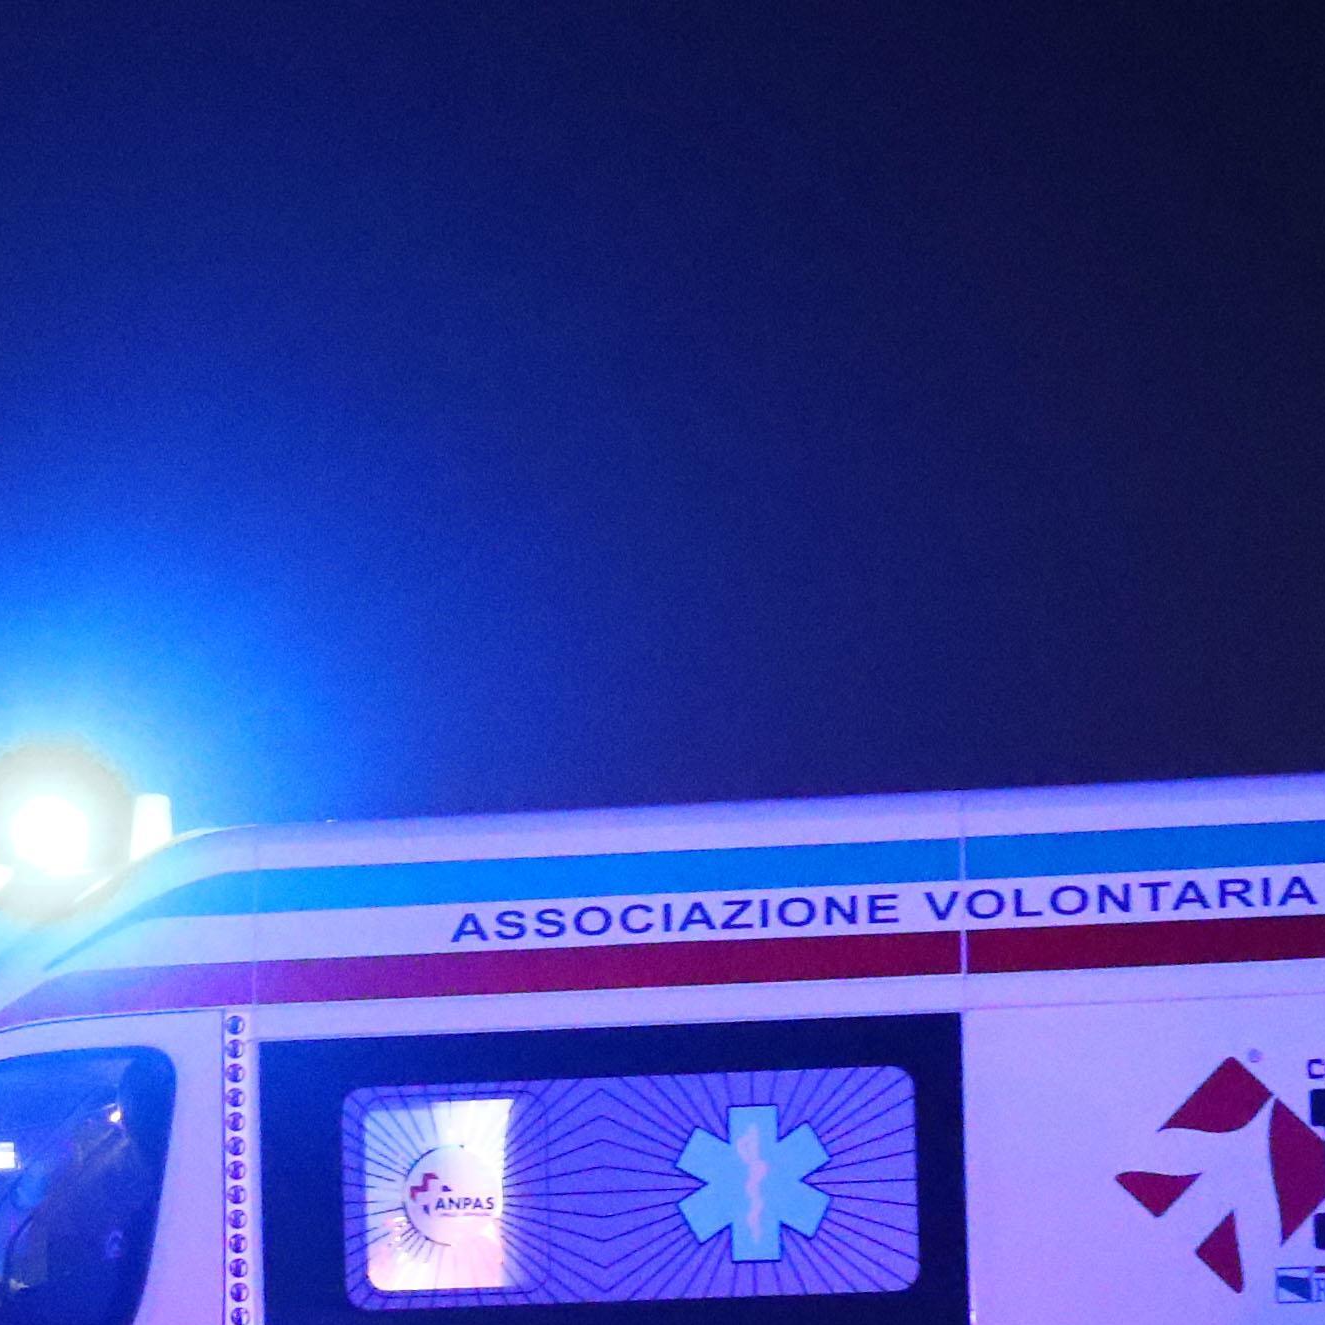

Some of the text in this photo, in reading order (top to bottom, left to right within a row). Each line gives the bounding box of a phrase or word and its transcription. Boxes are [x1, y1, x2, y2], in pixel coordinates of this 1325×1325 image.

[451, 876, 1318, 942] ASSOCIAZIONE VOLONTARIA
[435, 1197, 495, 1211] ANPAS
